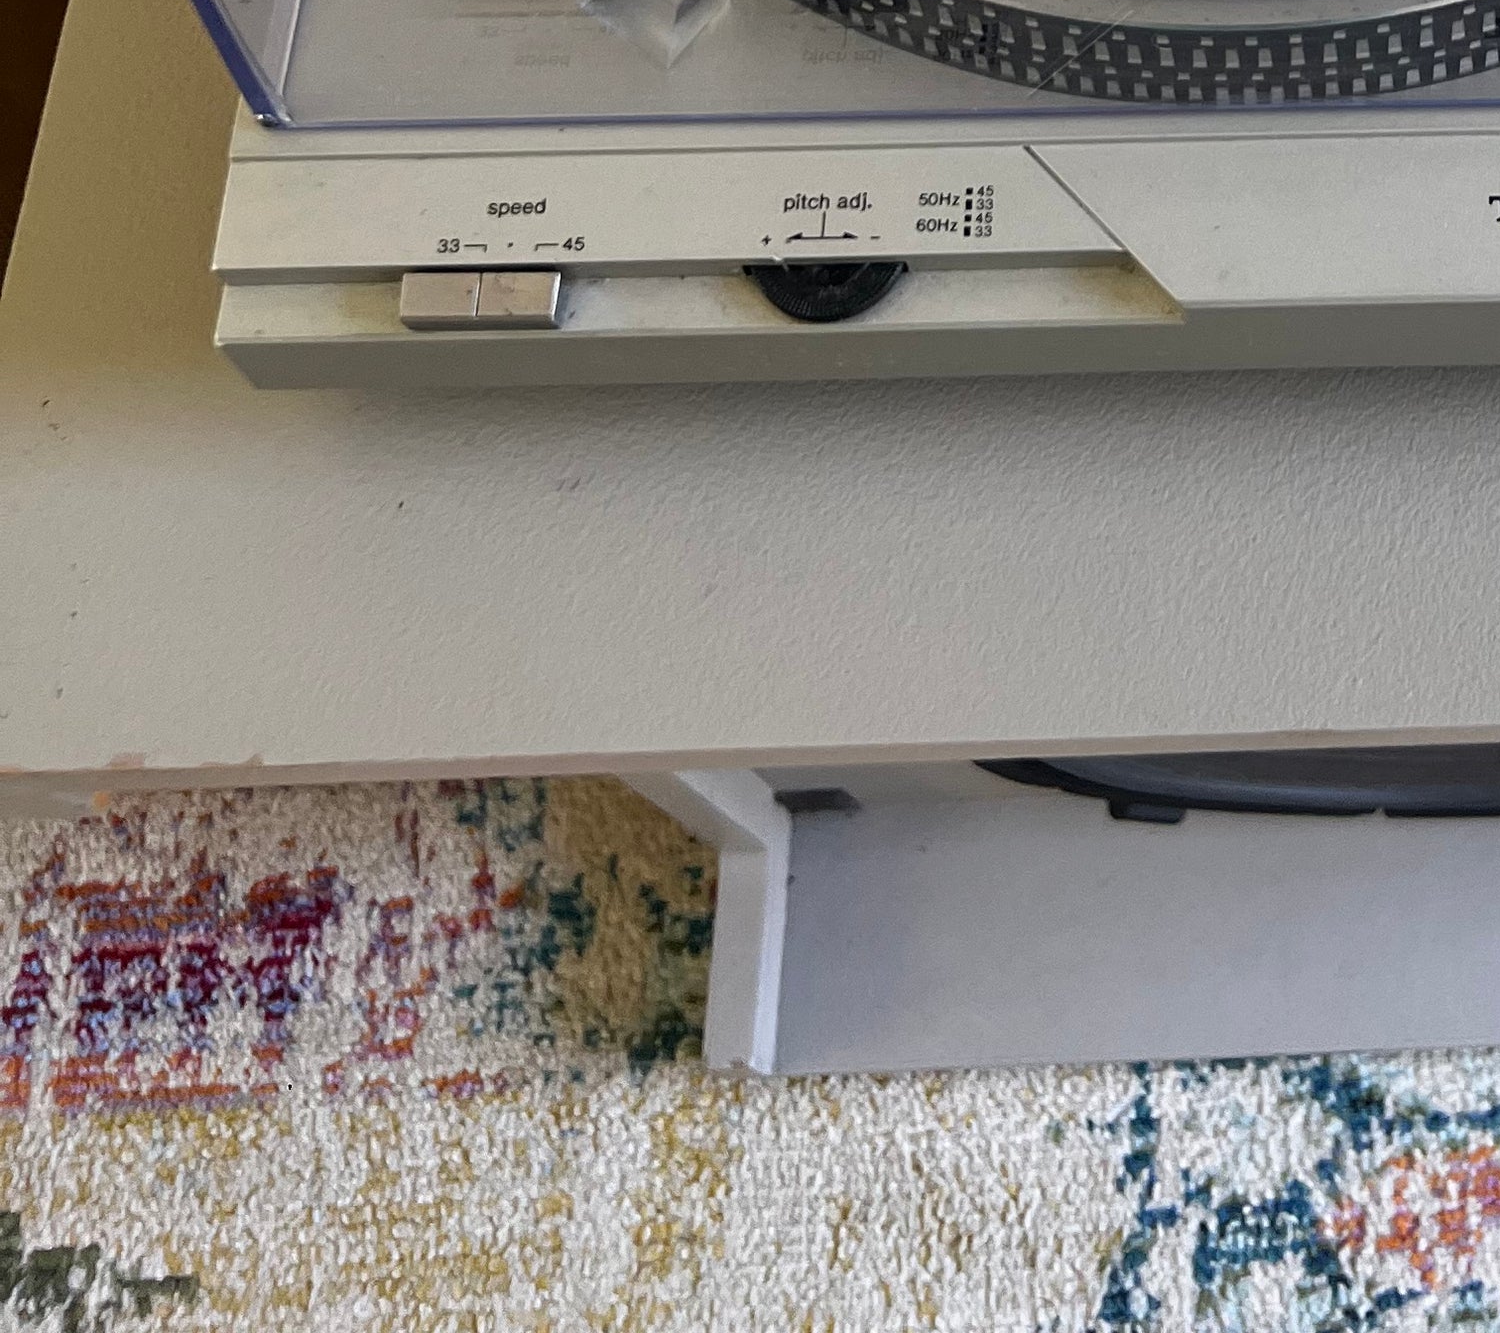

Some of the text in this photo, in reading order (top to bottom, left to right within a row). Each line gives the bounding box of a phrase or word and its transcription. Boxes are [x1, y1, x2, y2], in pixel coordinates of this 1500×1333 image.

[976, 184, 994, 197] 45
[783, 191, 873, 213] pitch adj.
[918, 191, 960, 207] 50Hz
[975, 197, 994, 211] 33
[487, 197, 547, 218] speed
[916, 217, 958, 233] 60Hz
[975, 212, 993, 224] 45
[974, 224, 993, 238] 33
[436, 236, 586, 254] 33 45
